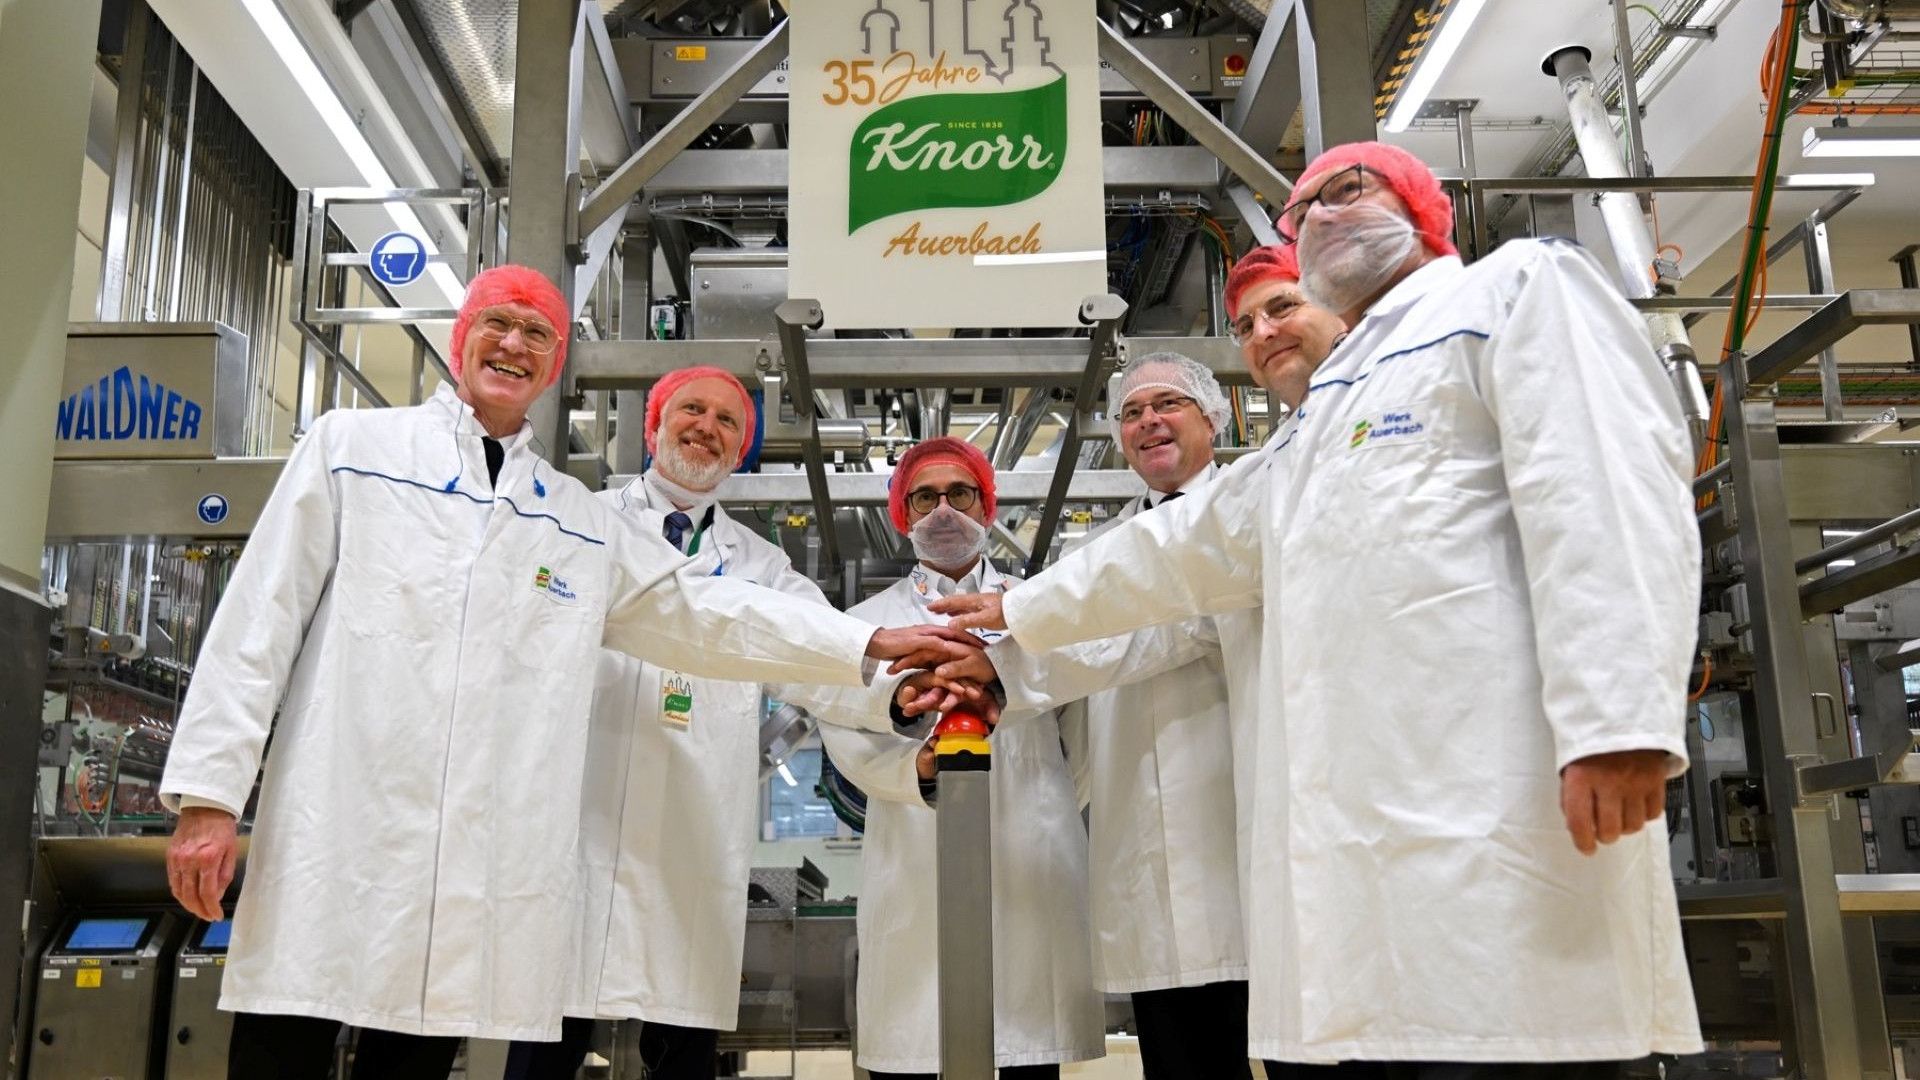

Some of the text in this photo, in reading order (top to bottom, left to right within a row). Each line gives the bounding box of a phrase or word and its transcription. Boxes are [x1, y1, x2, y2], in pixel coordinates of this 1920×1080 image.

[822, 50, 981, 106] 35 Jahre
[947, 121, 977, 129] SINCE
[861, 122, 1054, 171] Knorr
[882, 221, 1042, 258] Auerbach
[1369, 422, 1423, 438] Auerbach
[1383, 412, 1411, 424] Werk
